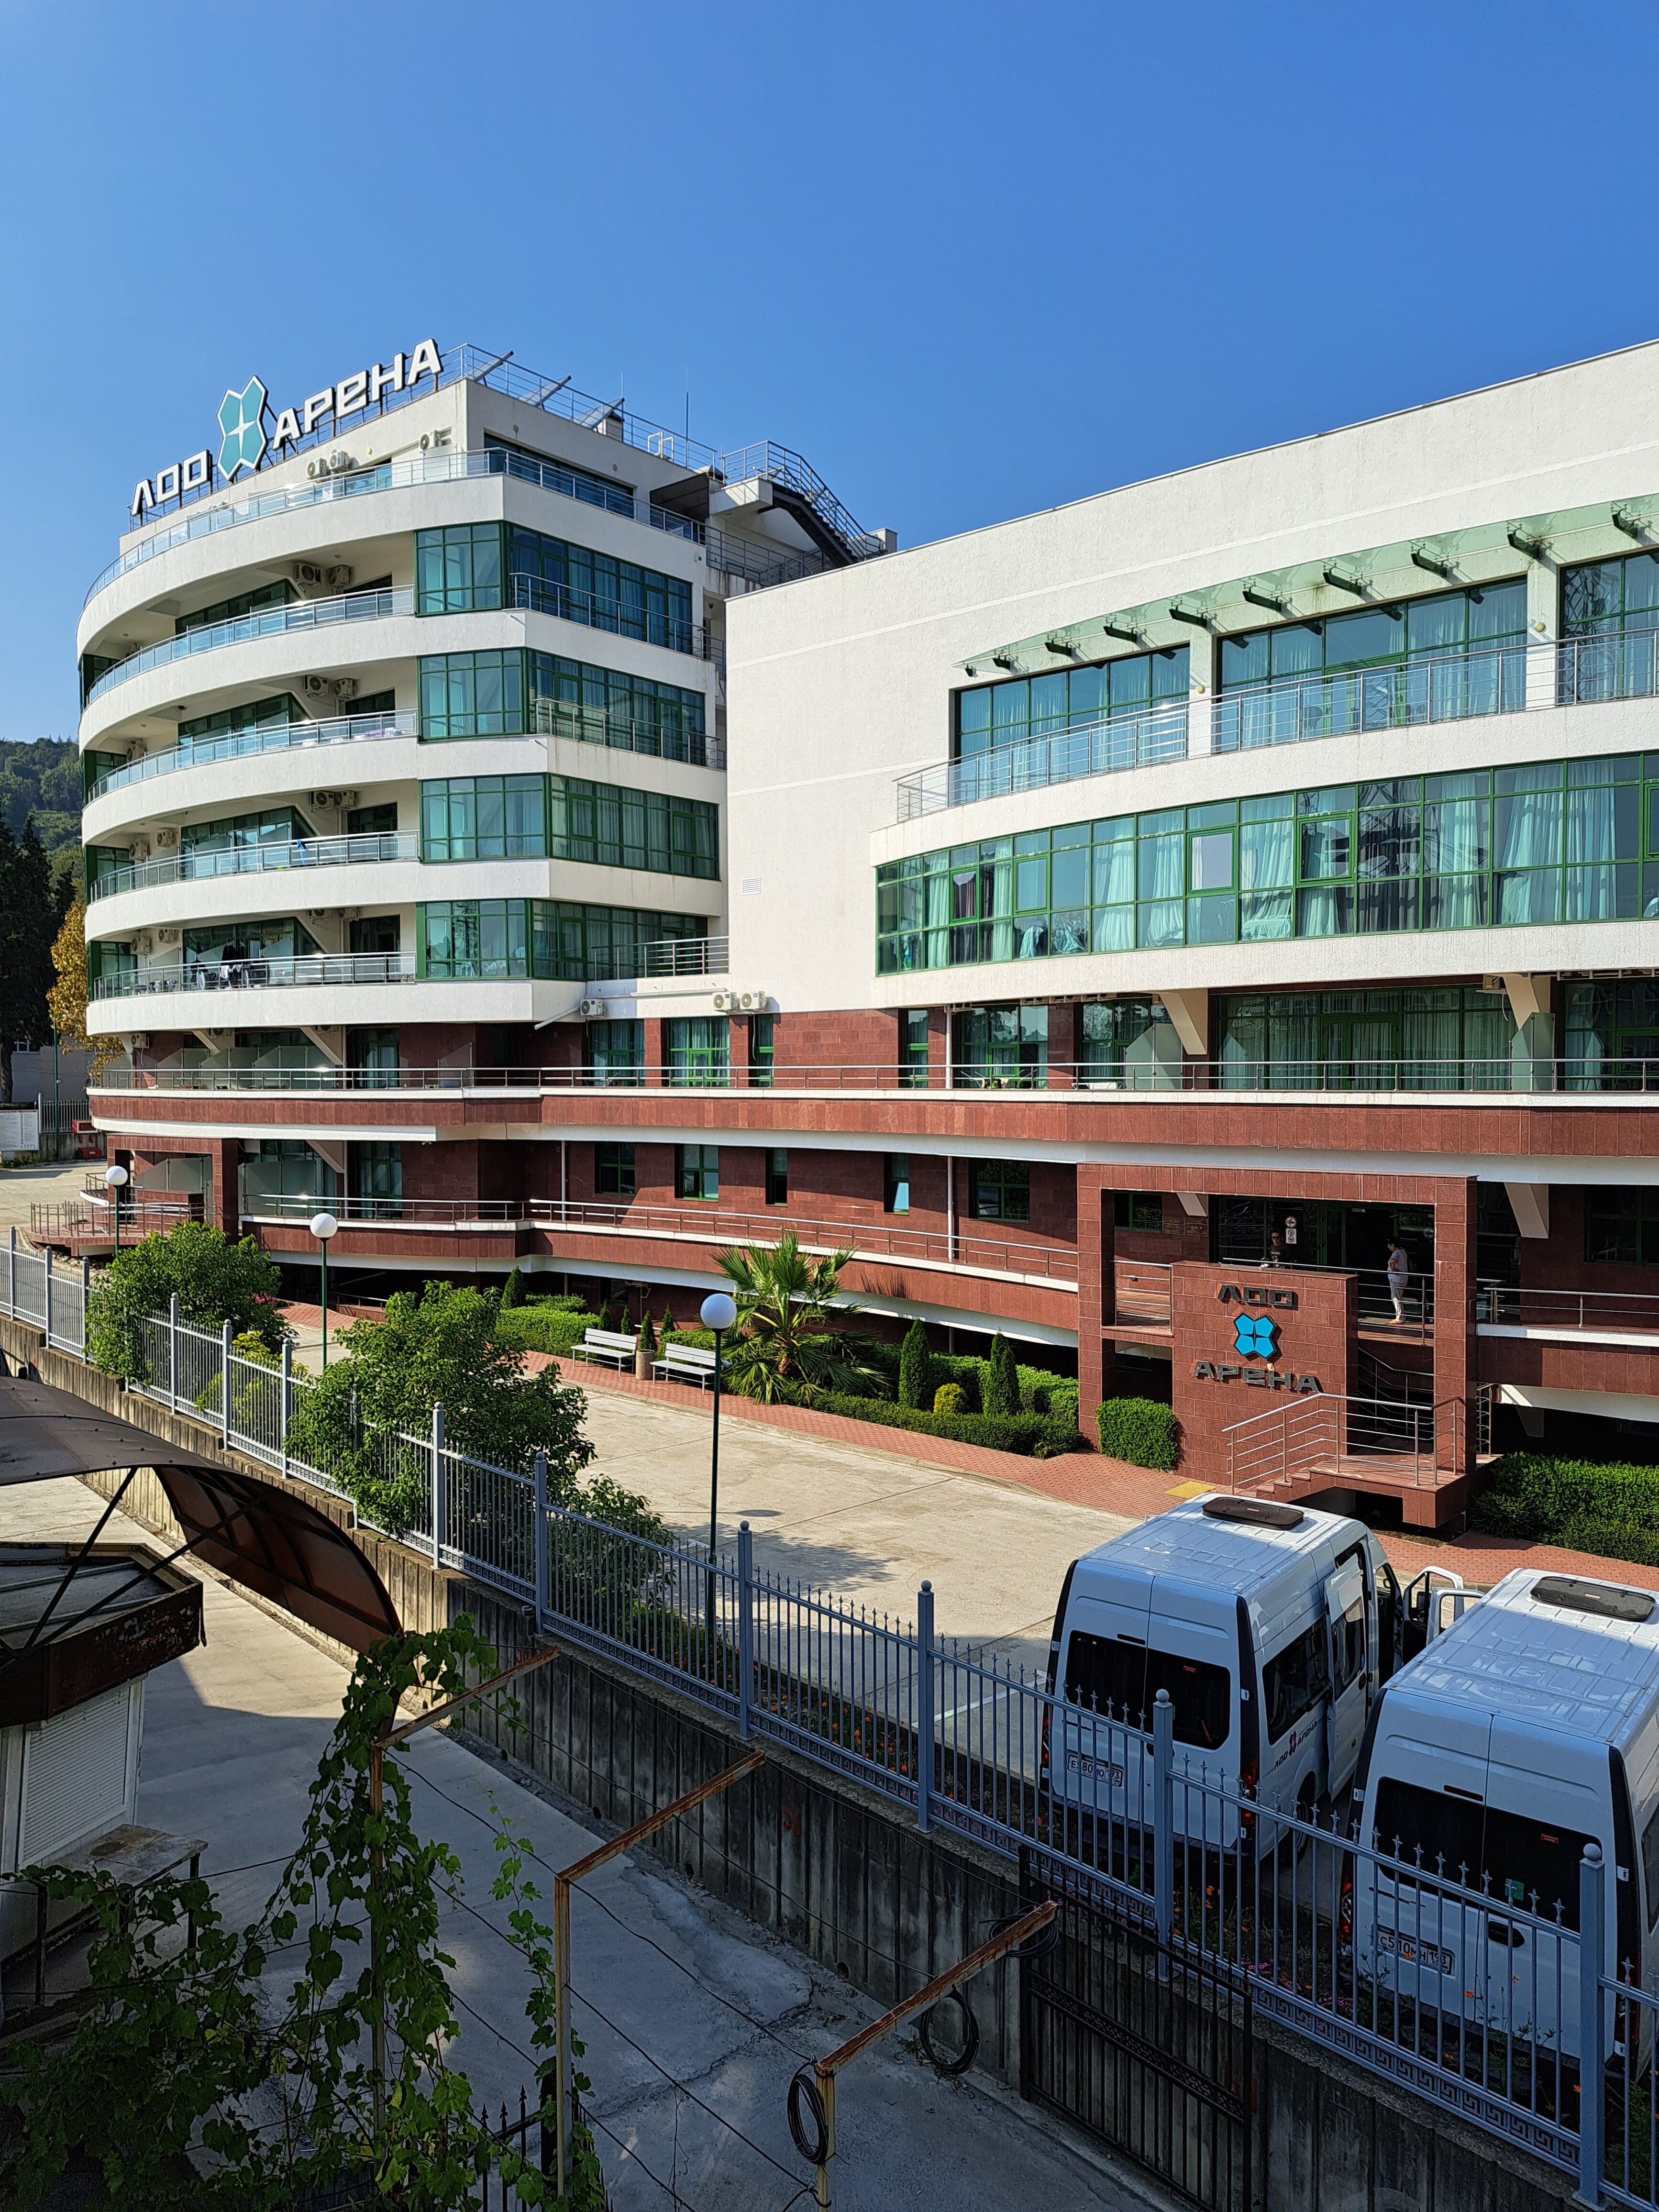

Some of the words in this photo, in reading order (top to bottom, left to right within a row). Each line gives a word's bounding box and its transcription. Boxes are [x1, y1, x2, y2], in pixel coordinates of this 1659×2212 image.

[132, 449, 210, 517] ЛОО
[272, 338, 443, 451] АРЕНА
[1217, 1284, 1293, 1307] ЛОО
[1192, 1360, 1319, 1393] АРЕНА
